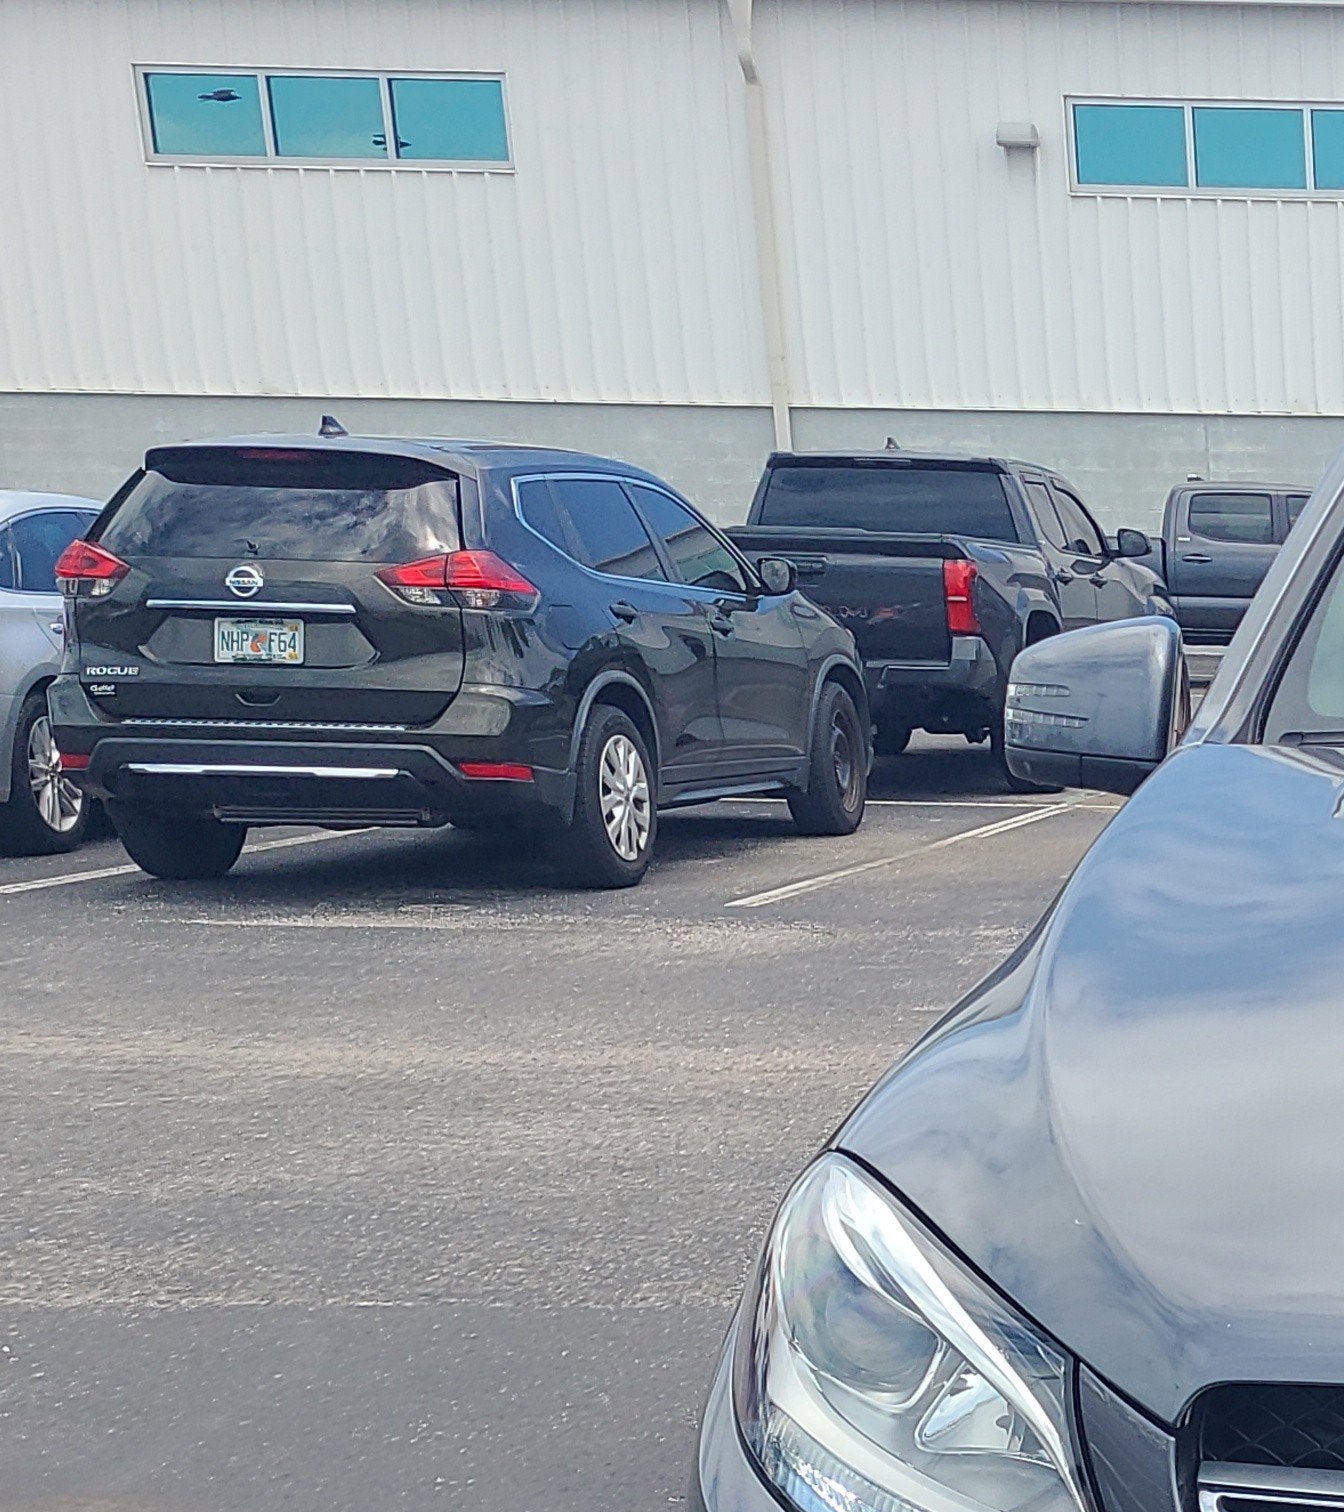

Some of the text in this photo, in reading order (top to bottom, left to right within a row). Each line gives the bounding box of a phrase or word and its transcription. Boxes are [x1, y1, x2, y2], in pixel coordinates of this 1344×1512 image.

[220, 630, 297, 653] NHP F64
[86, 666, 140, 676] ROGUE
